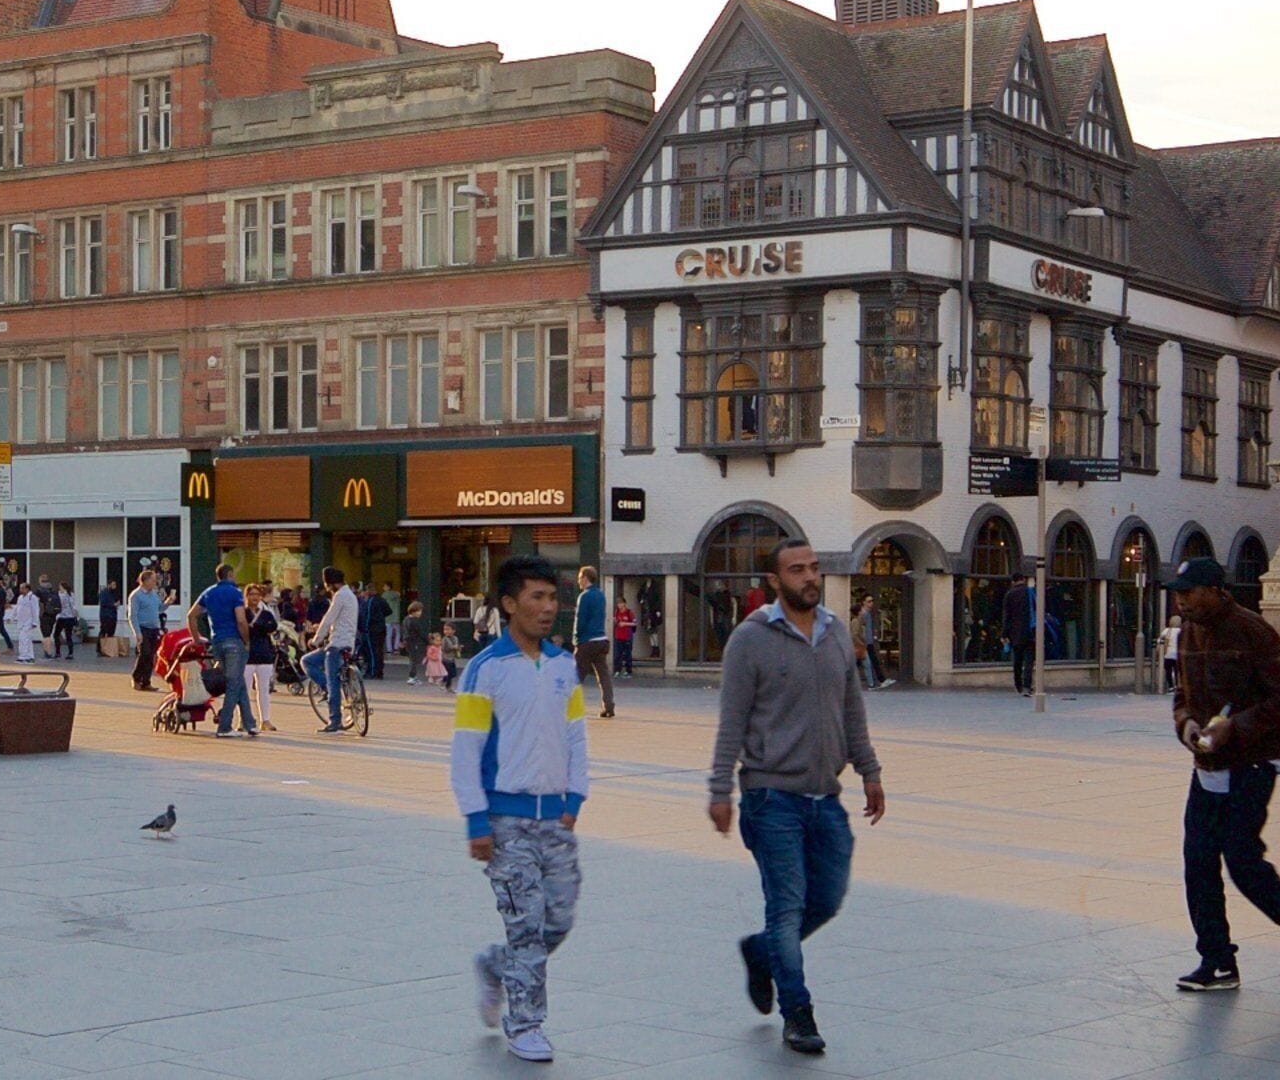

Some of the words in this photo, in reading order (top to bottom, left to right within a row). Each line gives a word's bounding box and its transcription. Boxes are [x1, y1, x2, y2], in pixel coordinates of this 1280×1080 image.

[675, 240, 803, 280] CRUISE
[1031, 259, 1092, 303] CRUISE
[457, 489, 565, 507] McDonald's
